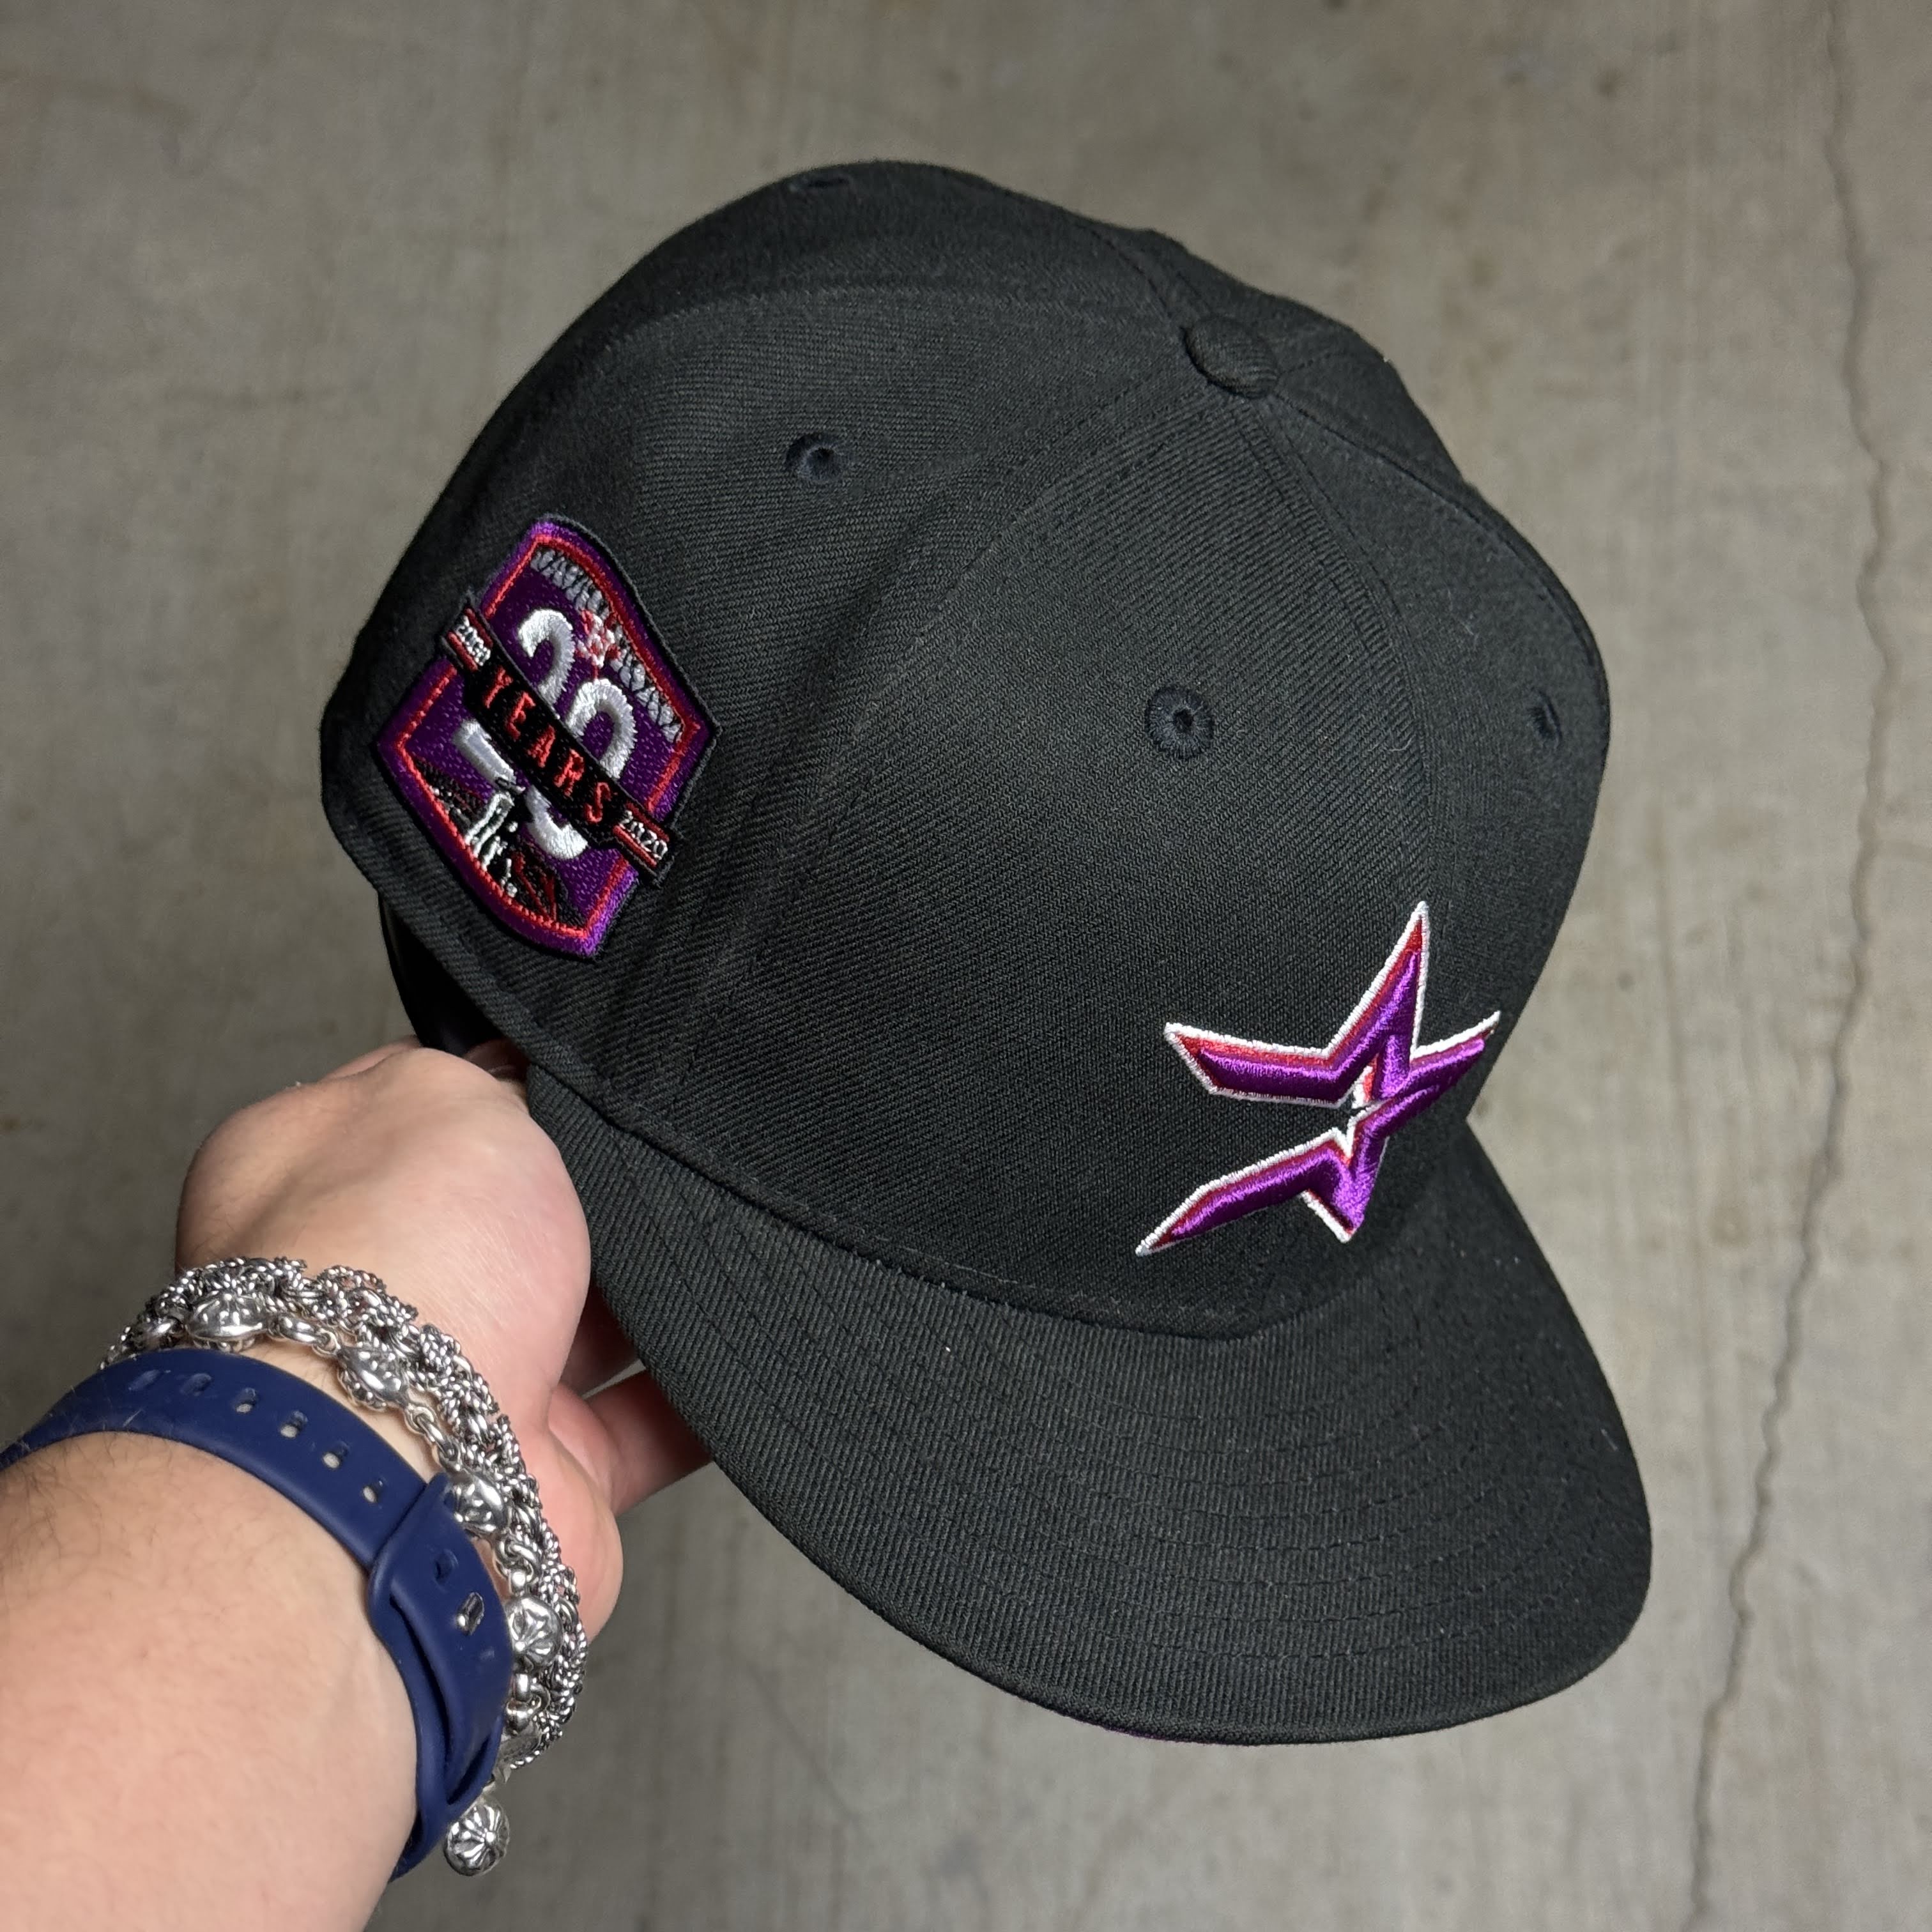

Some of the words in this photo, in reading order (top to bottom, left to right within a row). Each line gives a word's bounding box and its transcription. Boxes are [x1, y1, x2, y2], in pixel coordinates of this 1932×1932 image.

[451, 609, 637, 860] 20
[482, 666, 617, 825] YEARS
[618, 809, 668, 861] 2020
